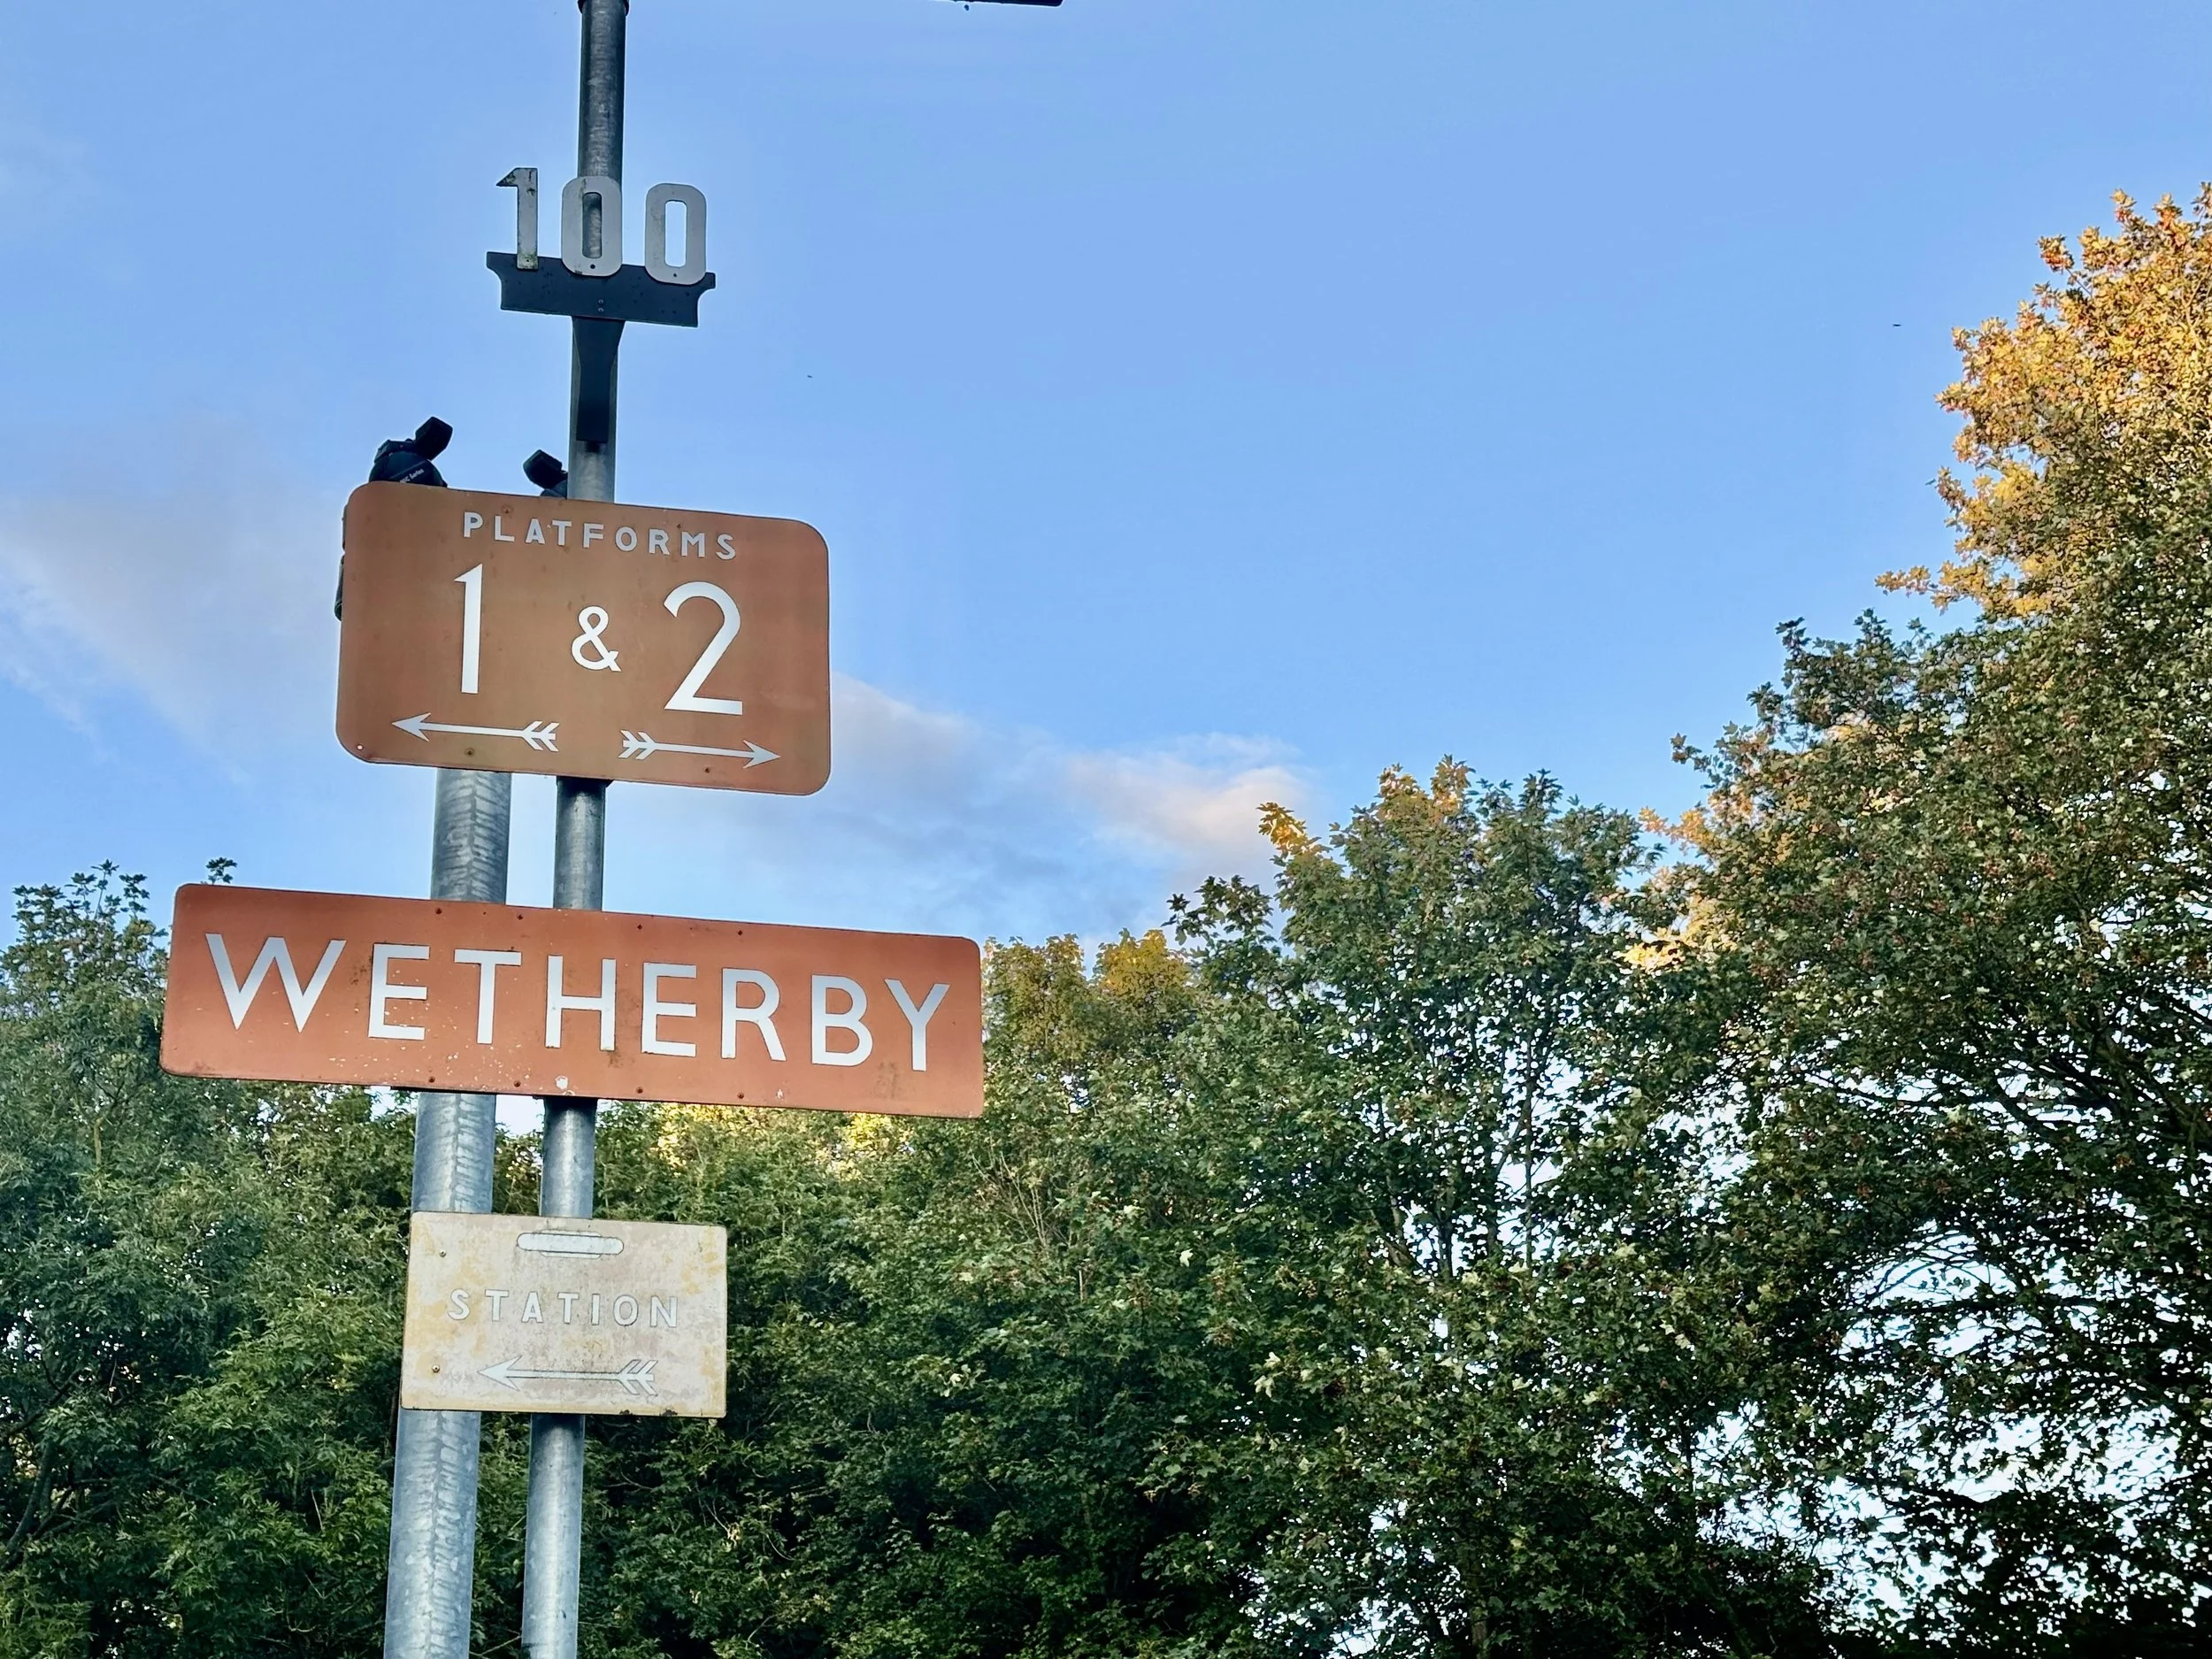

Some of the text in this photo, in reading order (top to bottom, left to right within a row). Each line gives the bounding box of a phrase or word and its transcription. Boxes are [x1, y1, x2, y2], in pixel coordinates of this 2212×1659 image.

[495, 167, 707, 285] 100
[463, 511, 737, 561] PLATFORMS
[453, 563, 743, 716] 1 & 2
[204, 932, 950, 1072] WETHERBY
[447, 1288, 679, 1328] STATION
